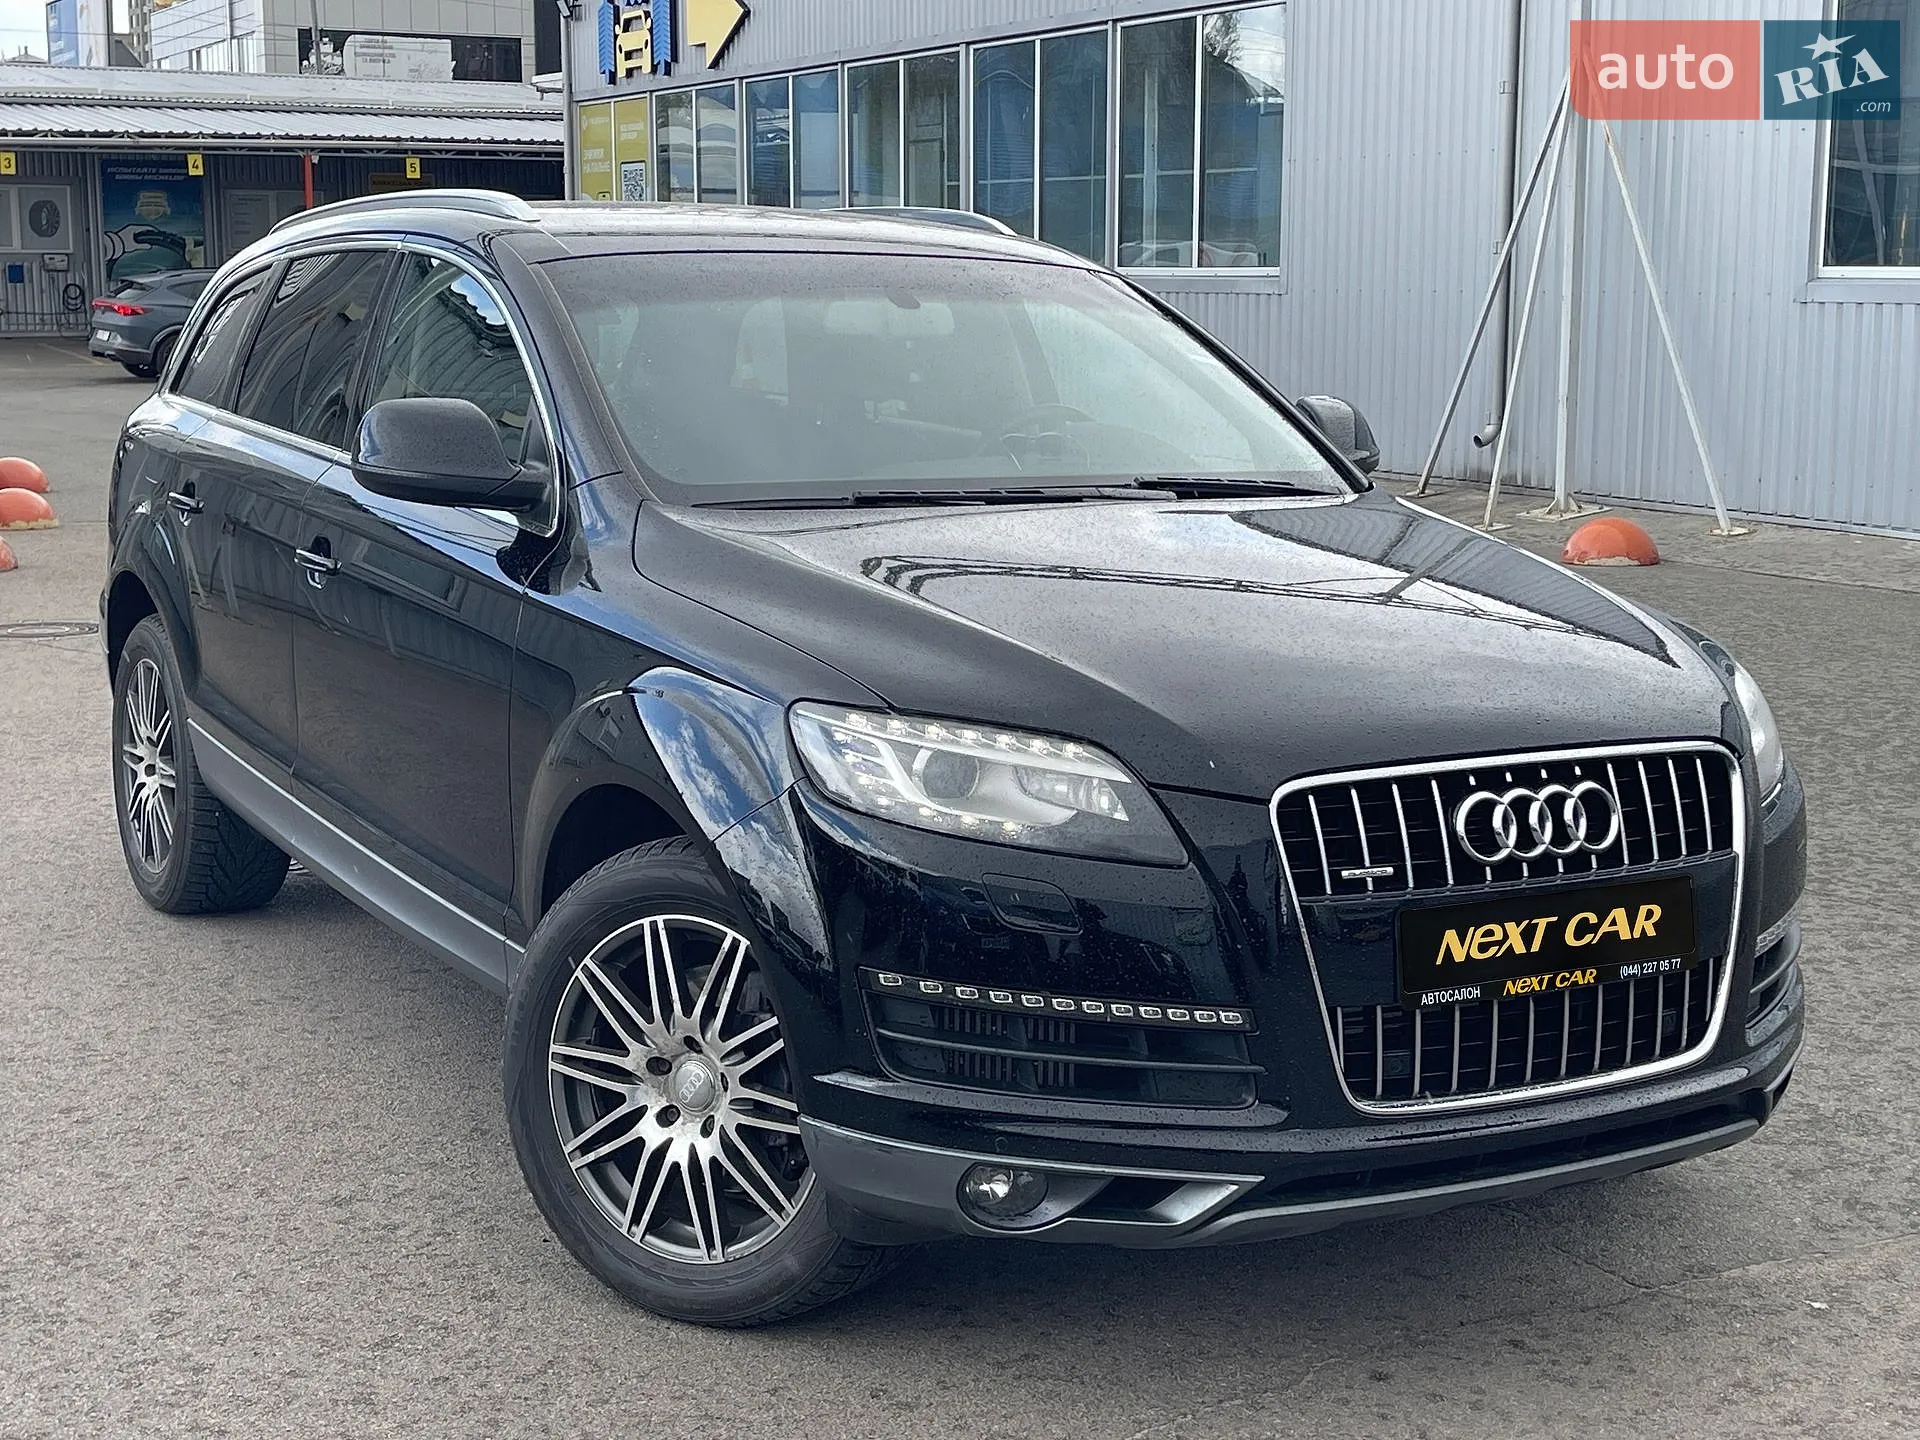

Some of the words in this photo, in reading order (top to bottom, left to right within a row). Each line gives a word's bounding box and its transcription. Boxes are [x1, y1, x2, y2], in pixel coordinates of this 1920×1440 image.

[4, 157, 12, 169] 3
[191, 159, 200, 170] 4
[409, 162, 417, 173] 5
[1564, 904, 1662, 947] CAR
[1420, 986, 1481, 1006] АВТОСАЛОН
[1555, 968, 1597, 988] CAR
[1619, 963, 1641, 980] (044)
[1643, 961, 1658, 974] 227
[1659, 960, 1670, 971] 05
[1671, 958, 1682, 970] 77
